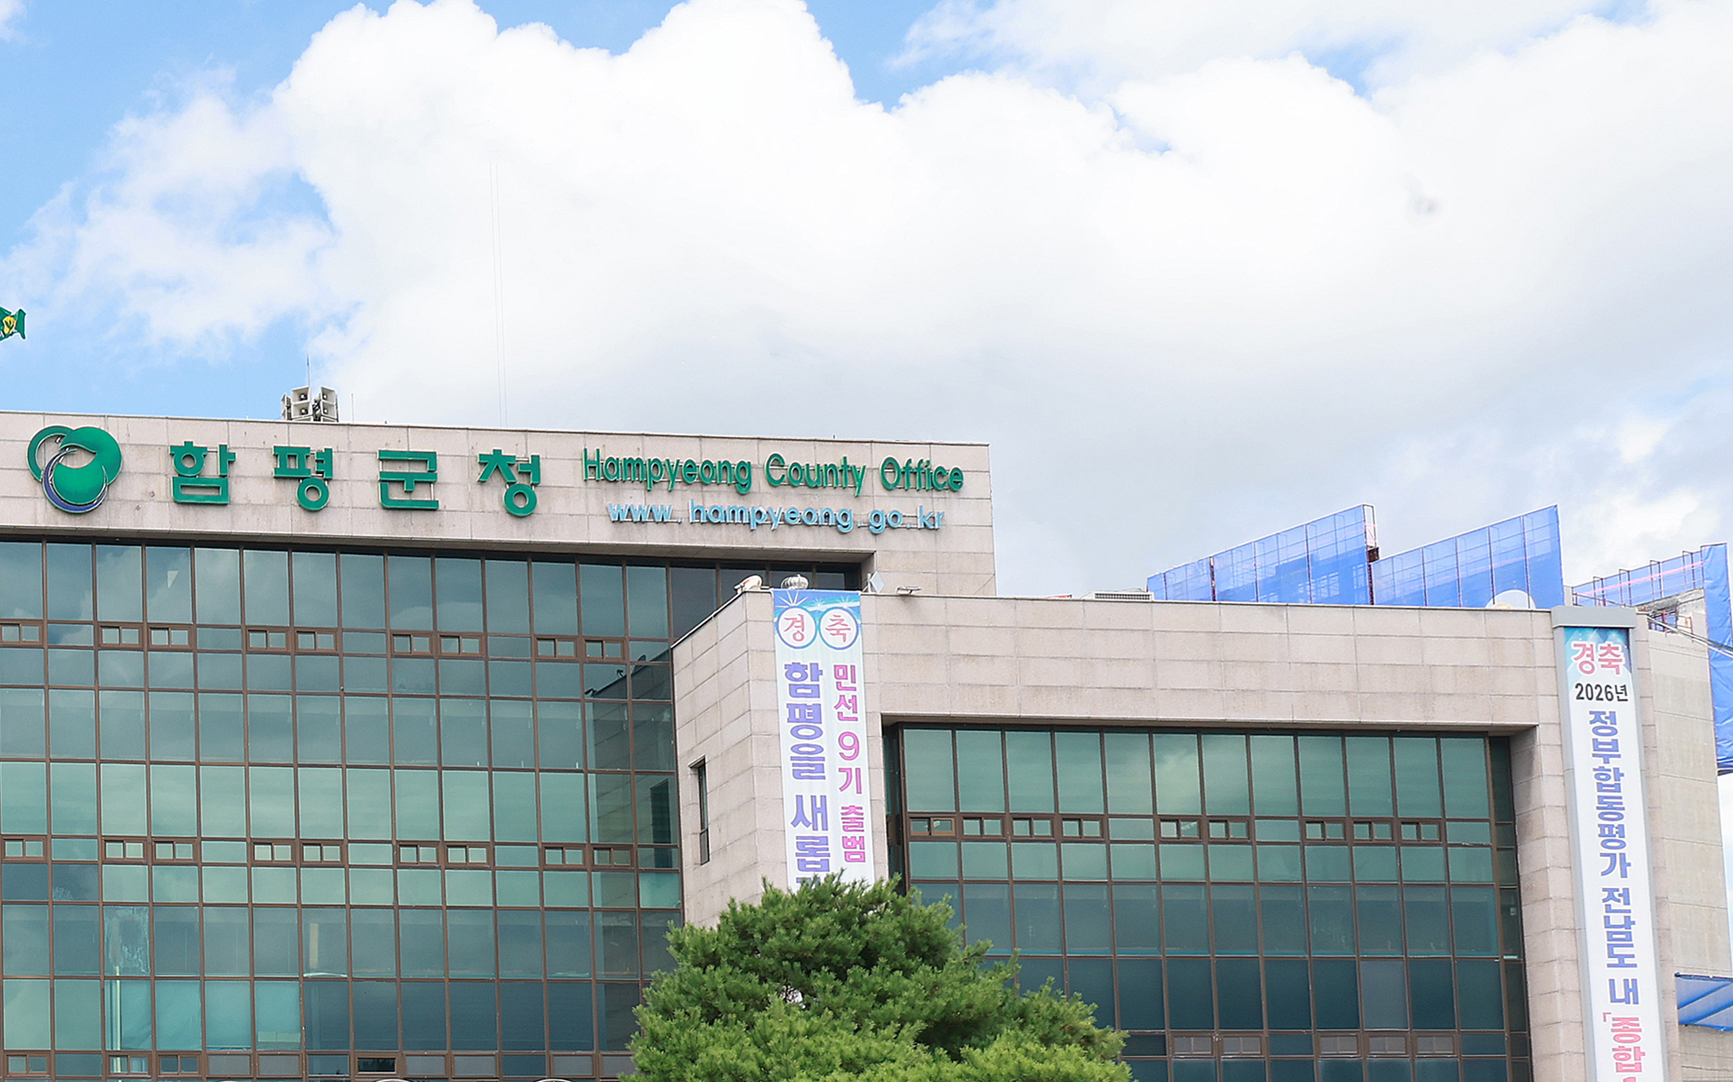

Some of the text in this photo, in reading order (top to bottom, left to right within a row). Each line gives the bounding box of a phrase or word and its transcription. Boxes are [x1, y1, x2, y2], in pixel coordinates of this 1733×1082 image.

[169, 441, 541, 518] 함평군청
[582, 448, 965, 497] Hampyeong County Office
[606, 500, 946, 535] www.hampyeong.go.kr
[784, 614, 851, 642] 경축
[1571, 640, 1626, 676] 경축
[833, 663, 859, 722] 민선
[1574, 682, 1629, 703] 2026년
[784, 661, 831, 885] 함평을 새롭
[1588, 709, 1632, 879] 정부합동평가
[840, 804, 866, 864] 출범
[1601, 886, 1638, 969] 전남도
[1608, 976, 1639, 1006] 내
